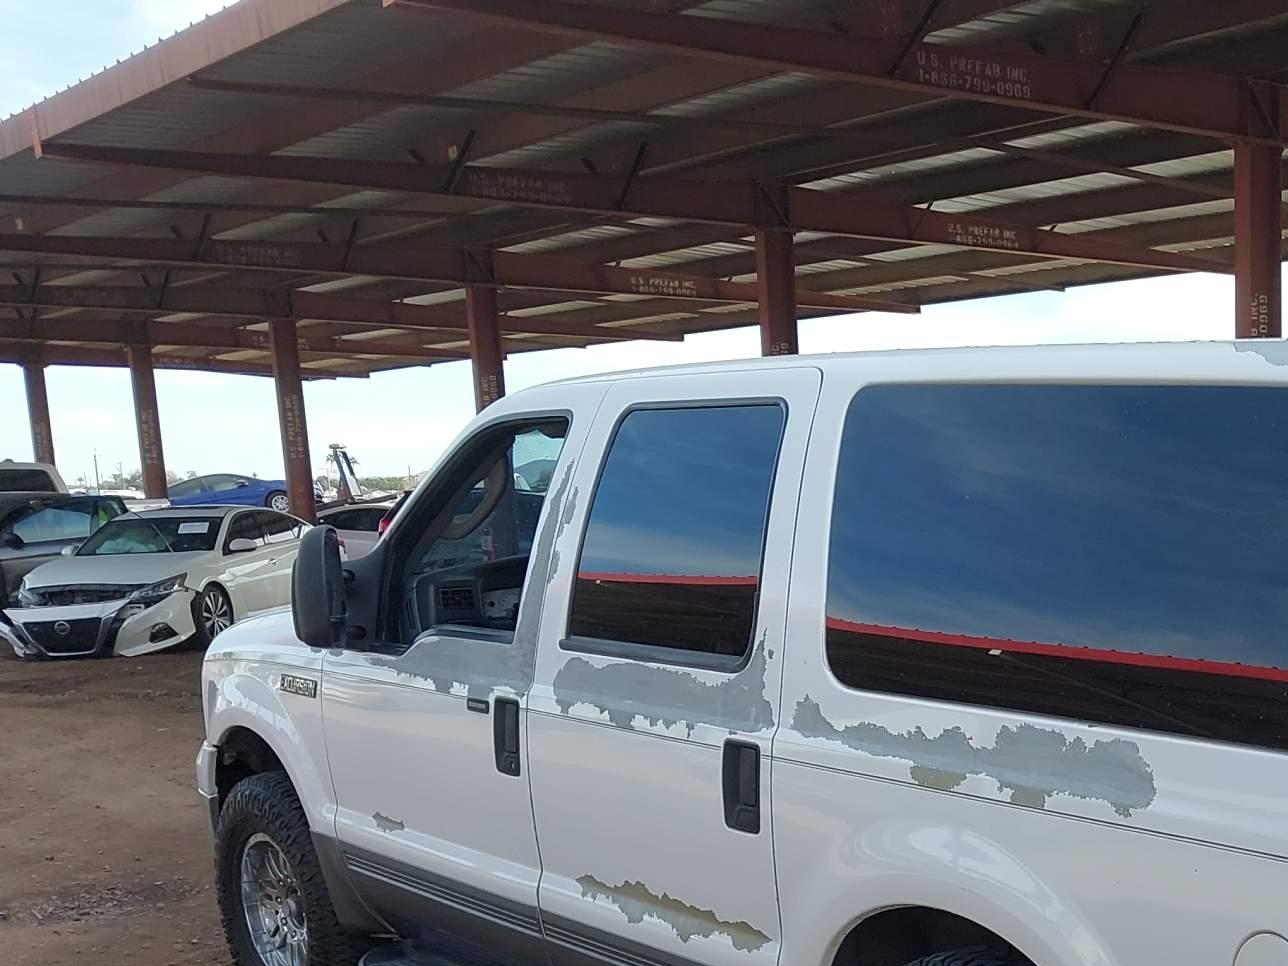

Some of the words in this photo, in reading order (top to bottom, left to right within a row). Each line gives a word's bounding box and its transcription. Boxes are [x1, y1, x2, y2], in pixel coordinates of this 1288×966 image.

[917, 50, 944, 68] U.S.
[949, 56, 1001, 77] PREFAB
[1006, 66, 1032, 83] INC.
[649, 277, 680, 288] PREFAB
